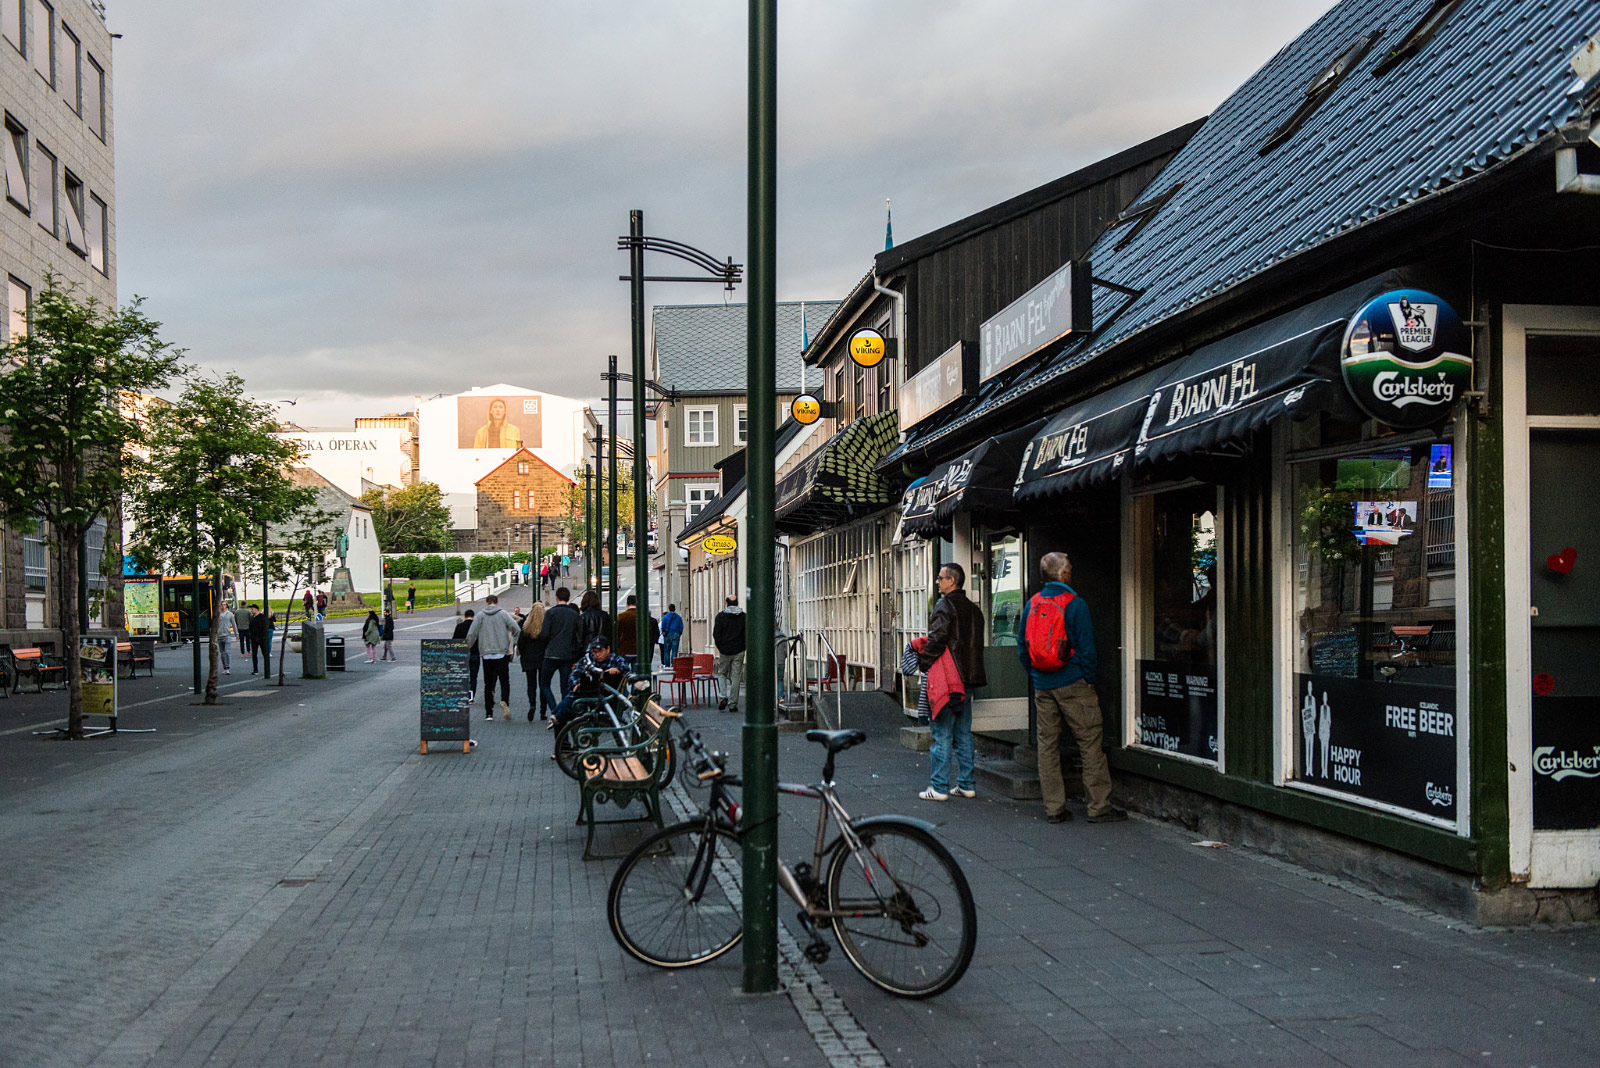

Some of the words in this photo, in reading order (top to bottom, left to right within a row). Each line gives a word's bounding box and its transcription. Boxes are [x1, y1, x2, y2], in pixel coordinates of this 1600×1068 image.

[1027, 300, 1046, 346] FEL
[1400, 327, 1432, 336] PREMIER
[1402, 335, 1431, 343] LEAGUE
[1166, 374, 1228, 427] BJARNI
[1221, 360, 1259, 410] FEL
[1372, 371, 1455, 405] Carlsberg
[300, 439, 324, 451] SKA
[328, 437, 377, 451] ÓPERAN
[1066, 423, 1089, 461] FEL
[1145, 671, 1164, 682] ALCOHOL
[1167, 673, 1179, 684] BEER
[1385, 704, 1417, 731] FREE
[1419, 709, 1454, 737] BEER
[1330, 744, 1362, 767] HAPPY
[1532, 746, 1600, 778] Carlsber
[1333, 763, 1362, 786] HOUR
[1425, 781, 1453, 806] Carlsberg
